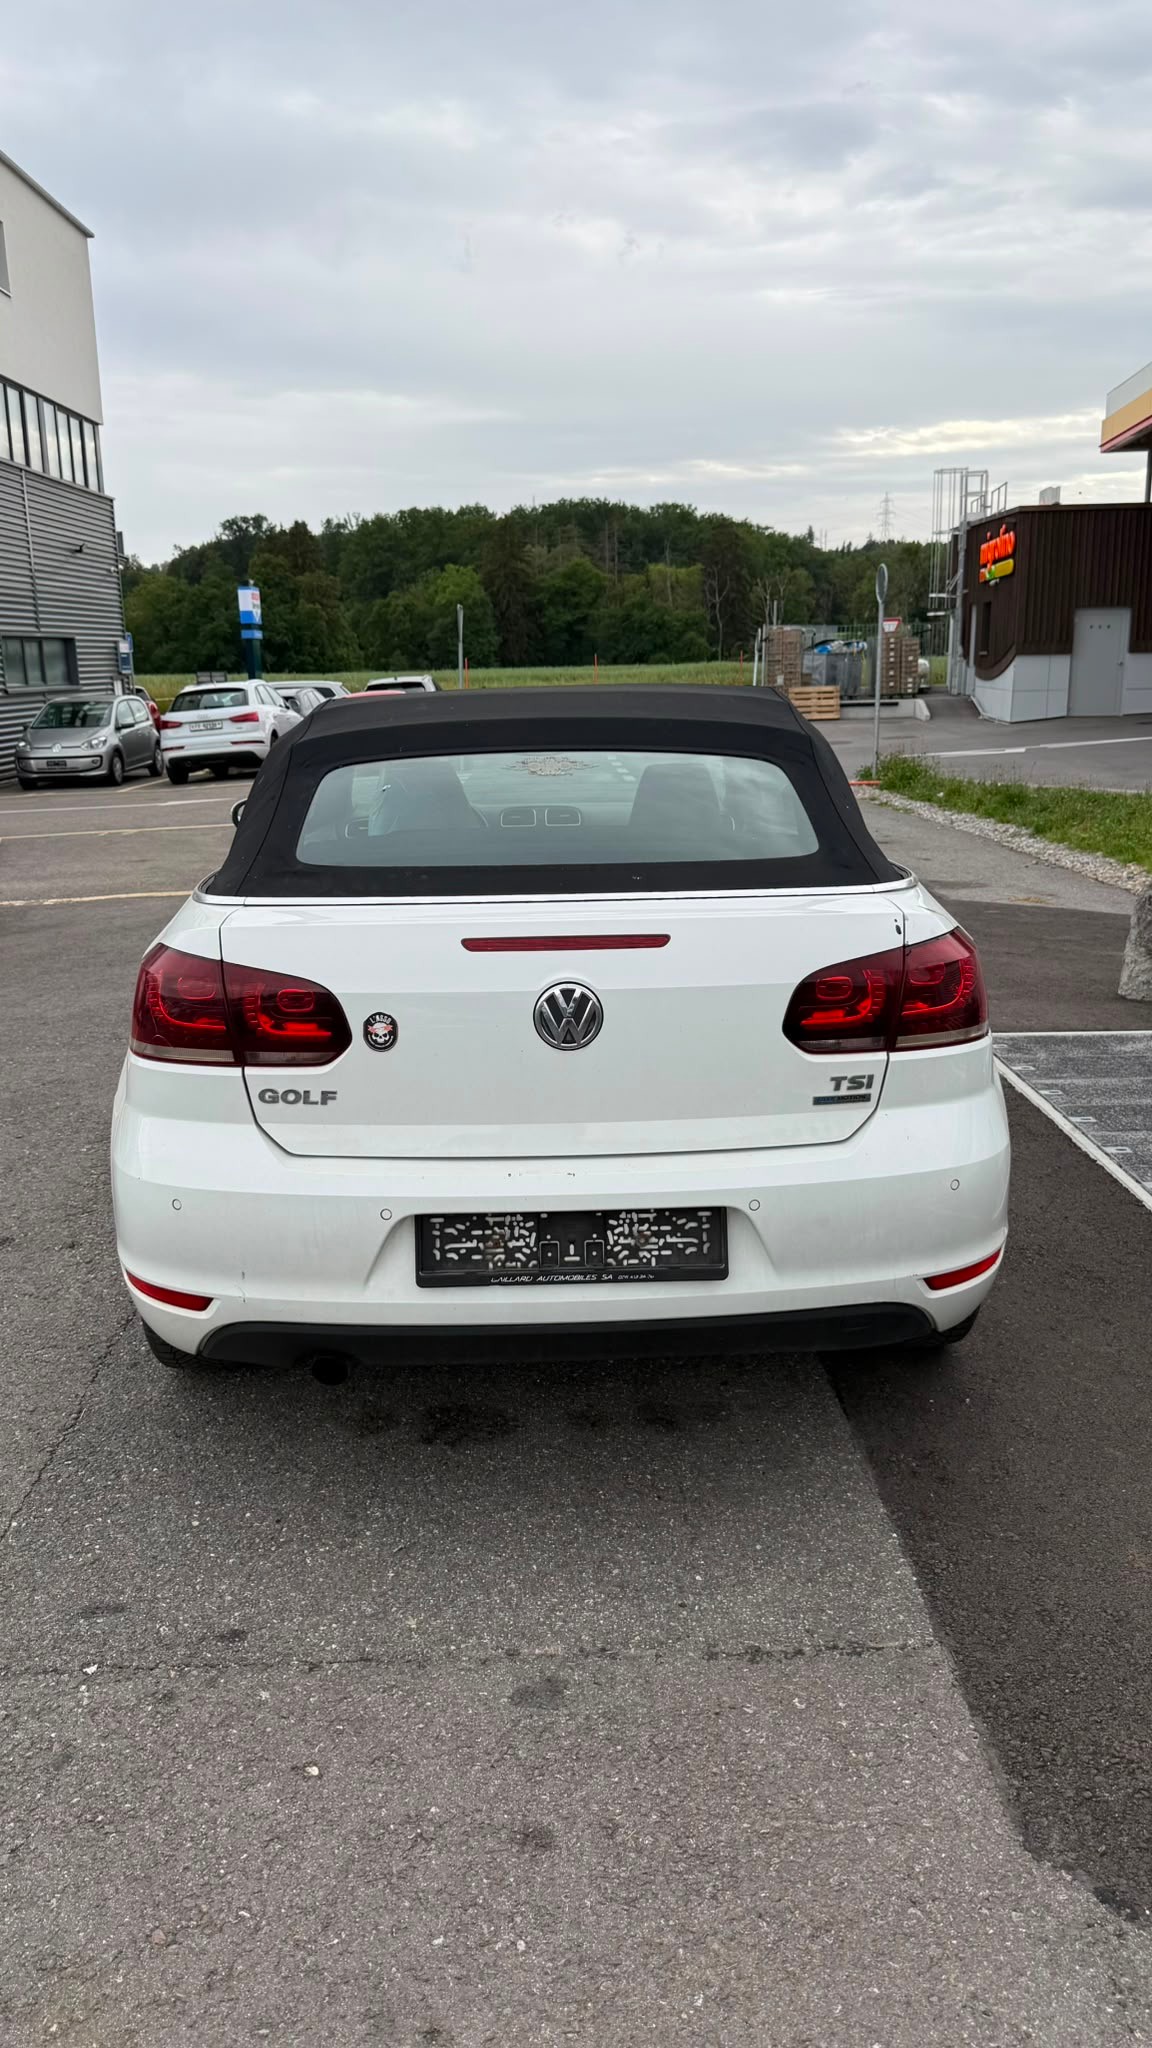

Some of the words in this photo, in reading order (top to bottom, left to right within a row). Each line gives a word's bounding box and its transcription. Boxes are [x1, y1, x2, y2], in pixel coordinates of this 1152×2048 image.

[829, 1074, 875, 1092] TSI
[258, 1088, 338, 1106] GOLF
[536, 1273, 598, 1282] AUTOMOBILES
[601, 1273, 613, 1281] SA
